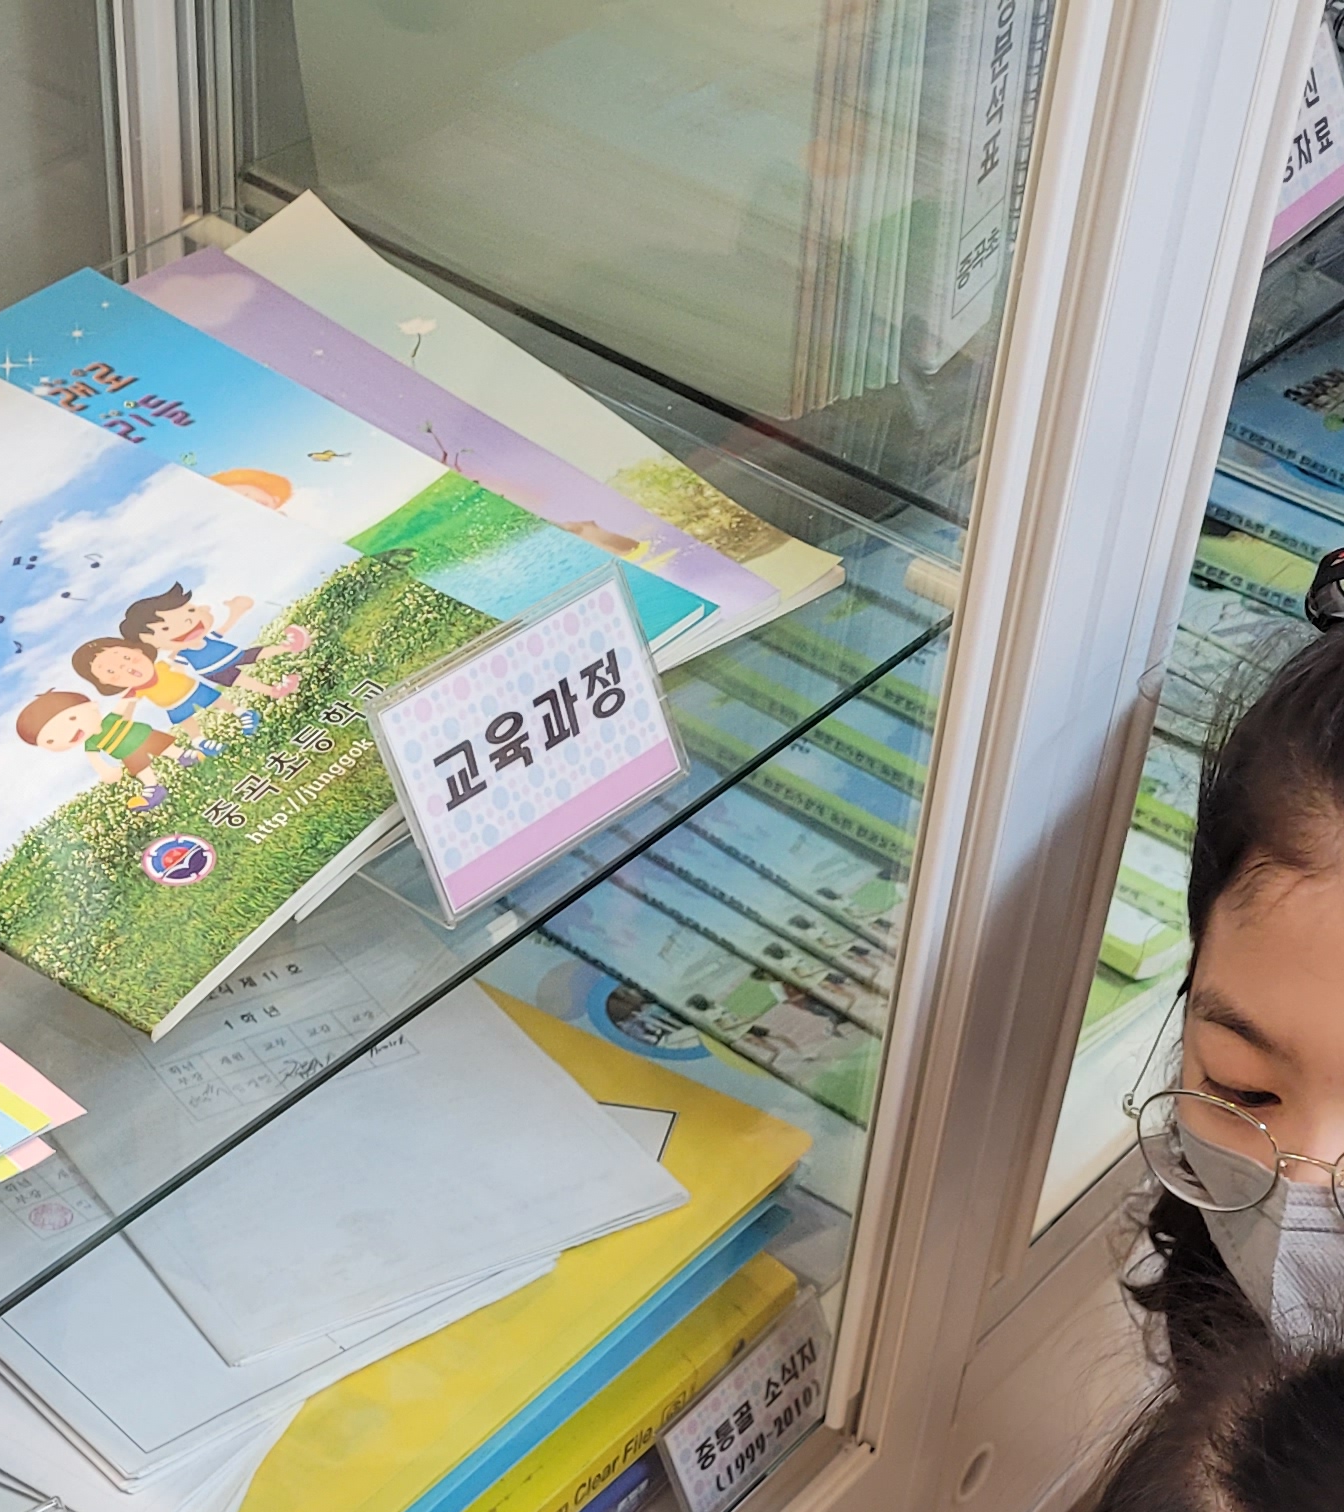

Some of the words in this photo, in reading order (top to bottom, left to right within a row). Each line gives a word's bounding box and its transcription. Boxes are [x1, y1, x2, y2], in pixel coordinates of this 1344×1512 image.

[957, 228, 1000, 291] 중곡초
[202, 679, 387, 828] 중곡초등학교
[433, 649, 627, 812] 교육과정
[573, 1456, 621, 1506] Clear
[621, 1426, 655, 1465] File
[695, 1400, 756, 1471] 중통골
[764, 1337, 818, 1408] 소식지
